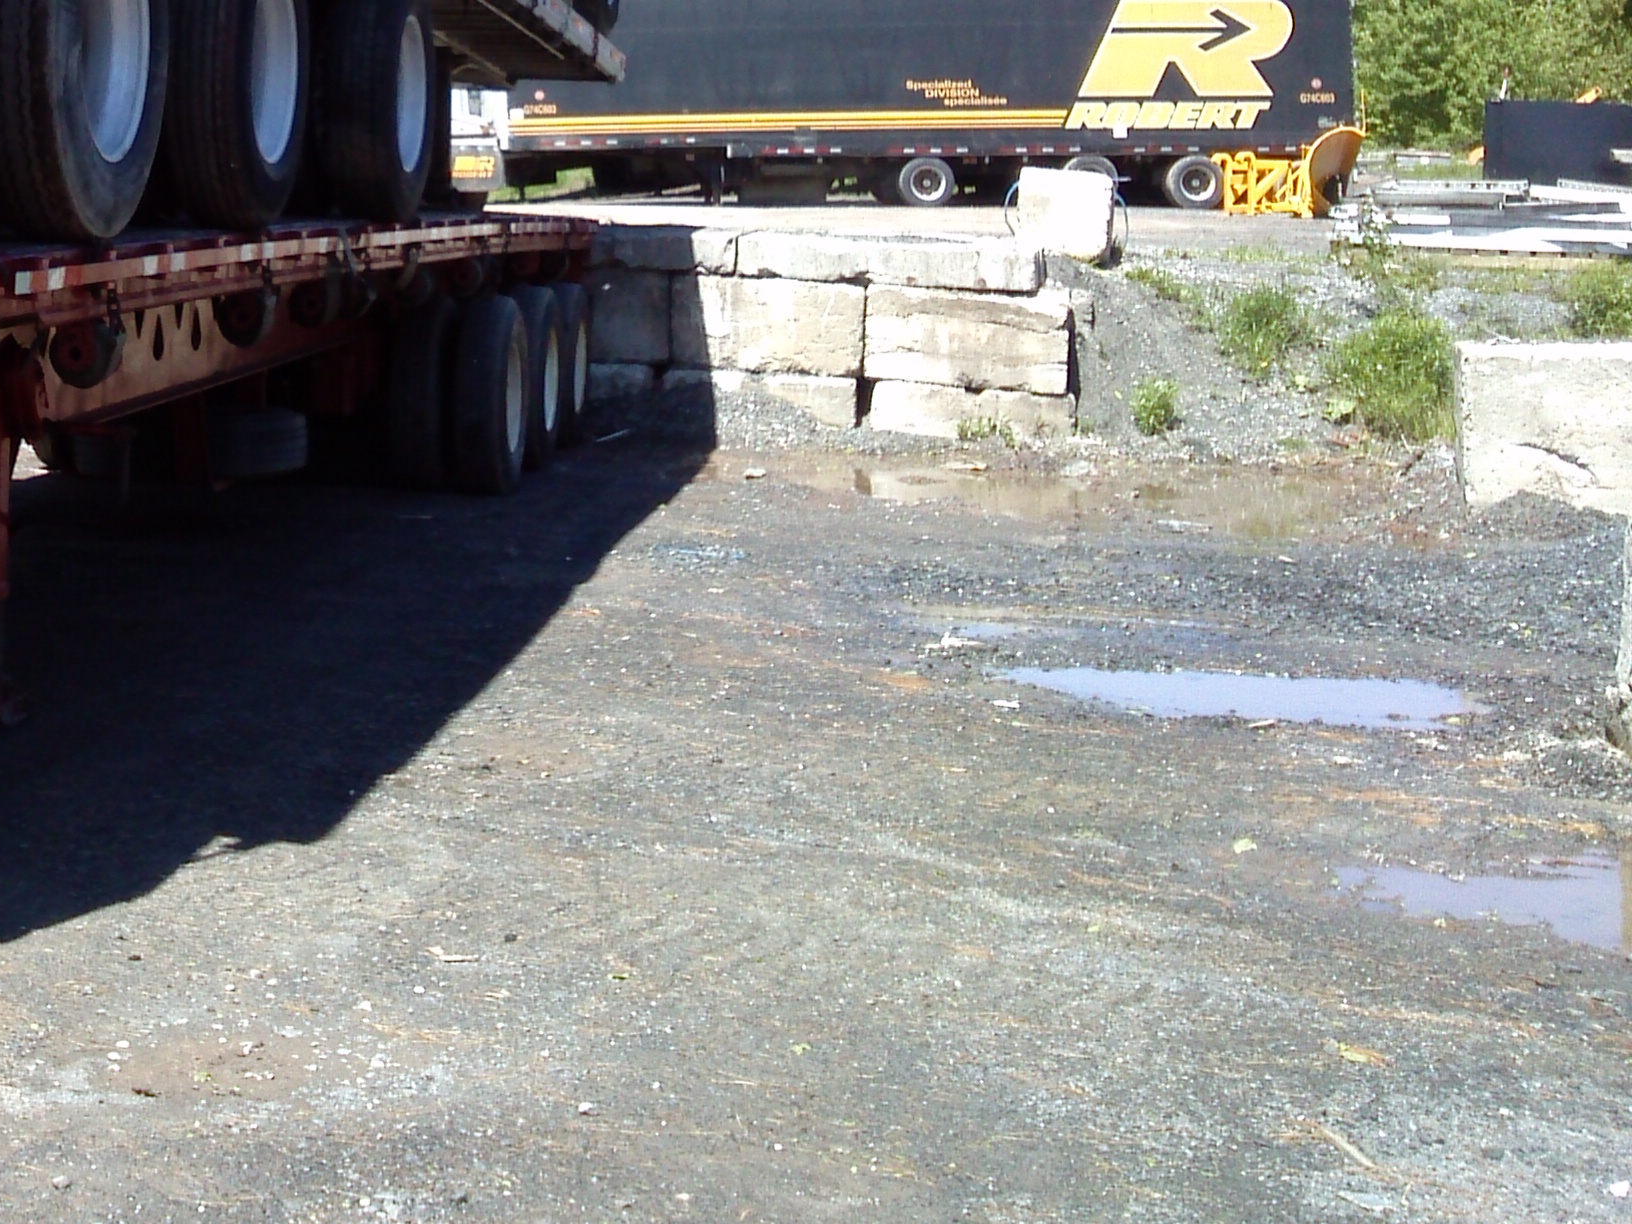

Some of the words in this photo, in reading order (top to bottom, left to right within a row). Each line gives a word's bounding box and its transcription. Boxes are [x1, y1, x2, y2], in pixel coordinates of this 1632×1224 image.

[905, 79, 973, 92] Specialized
[924, 88, 981, 99] DIVISION
[1065, 100, 1272, 129] ROBERT
